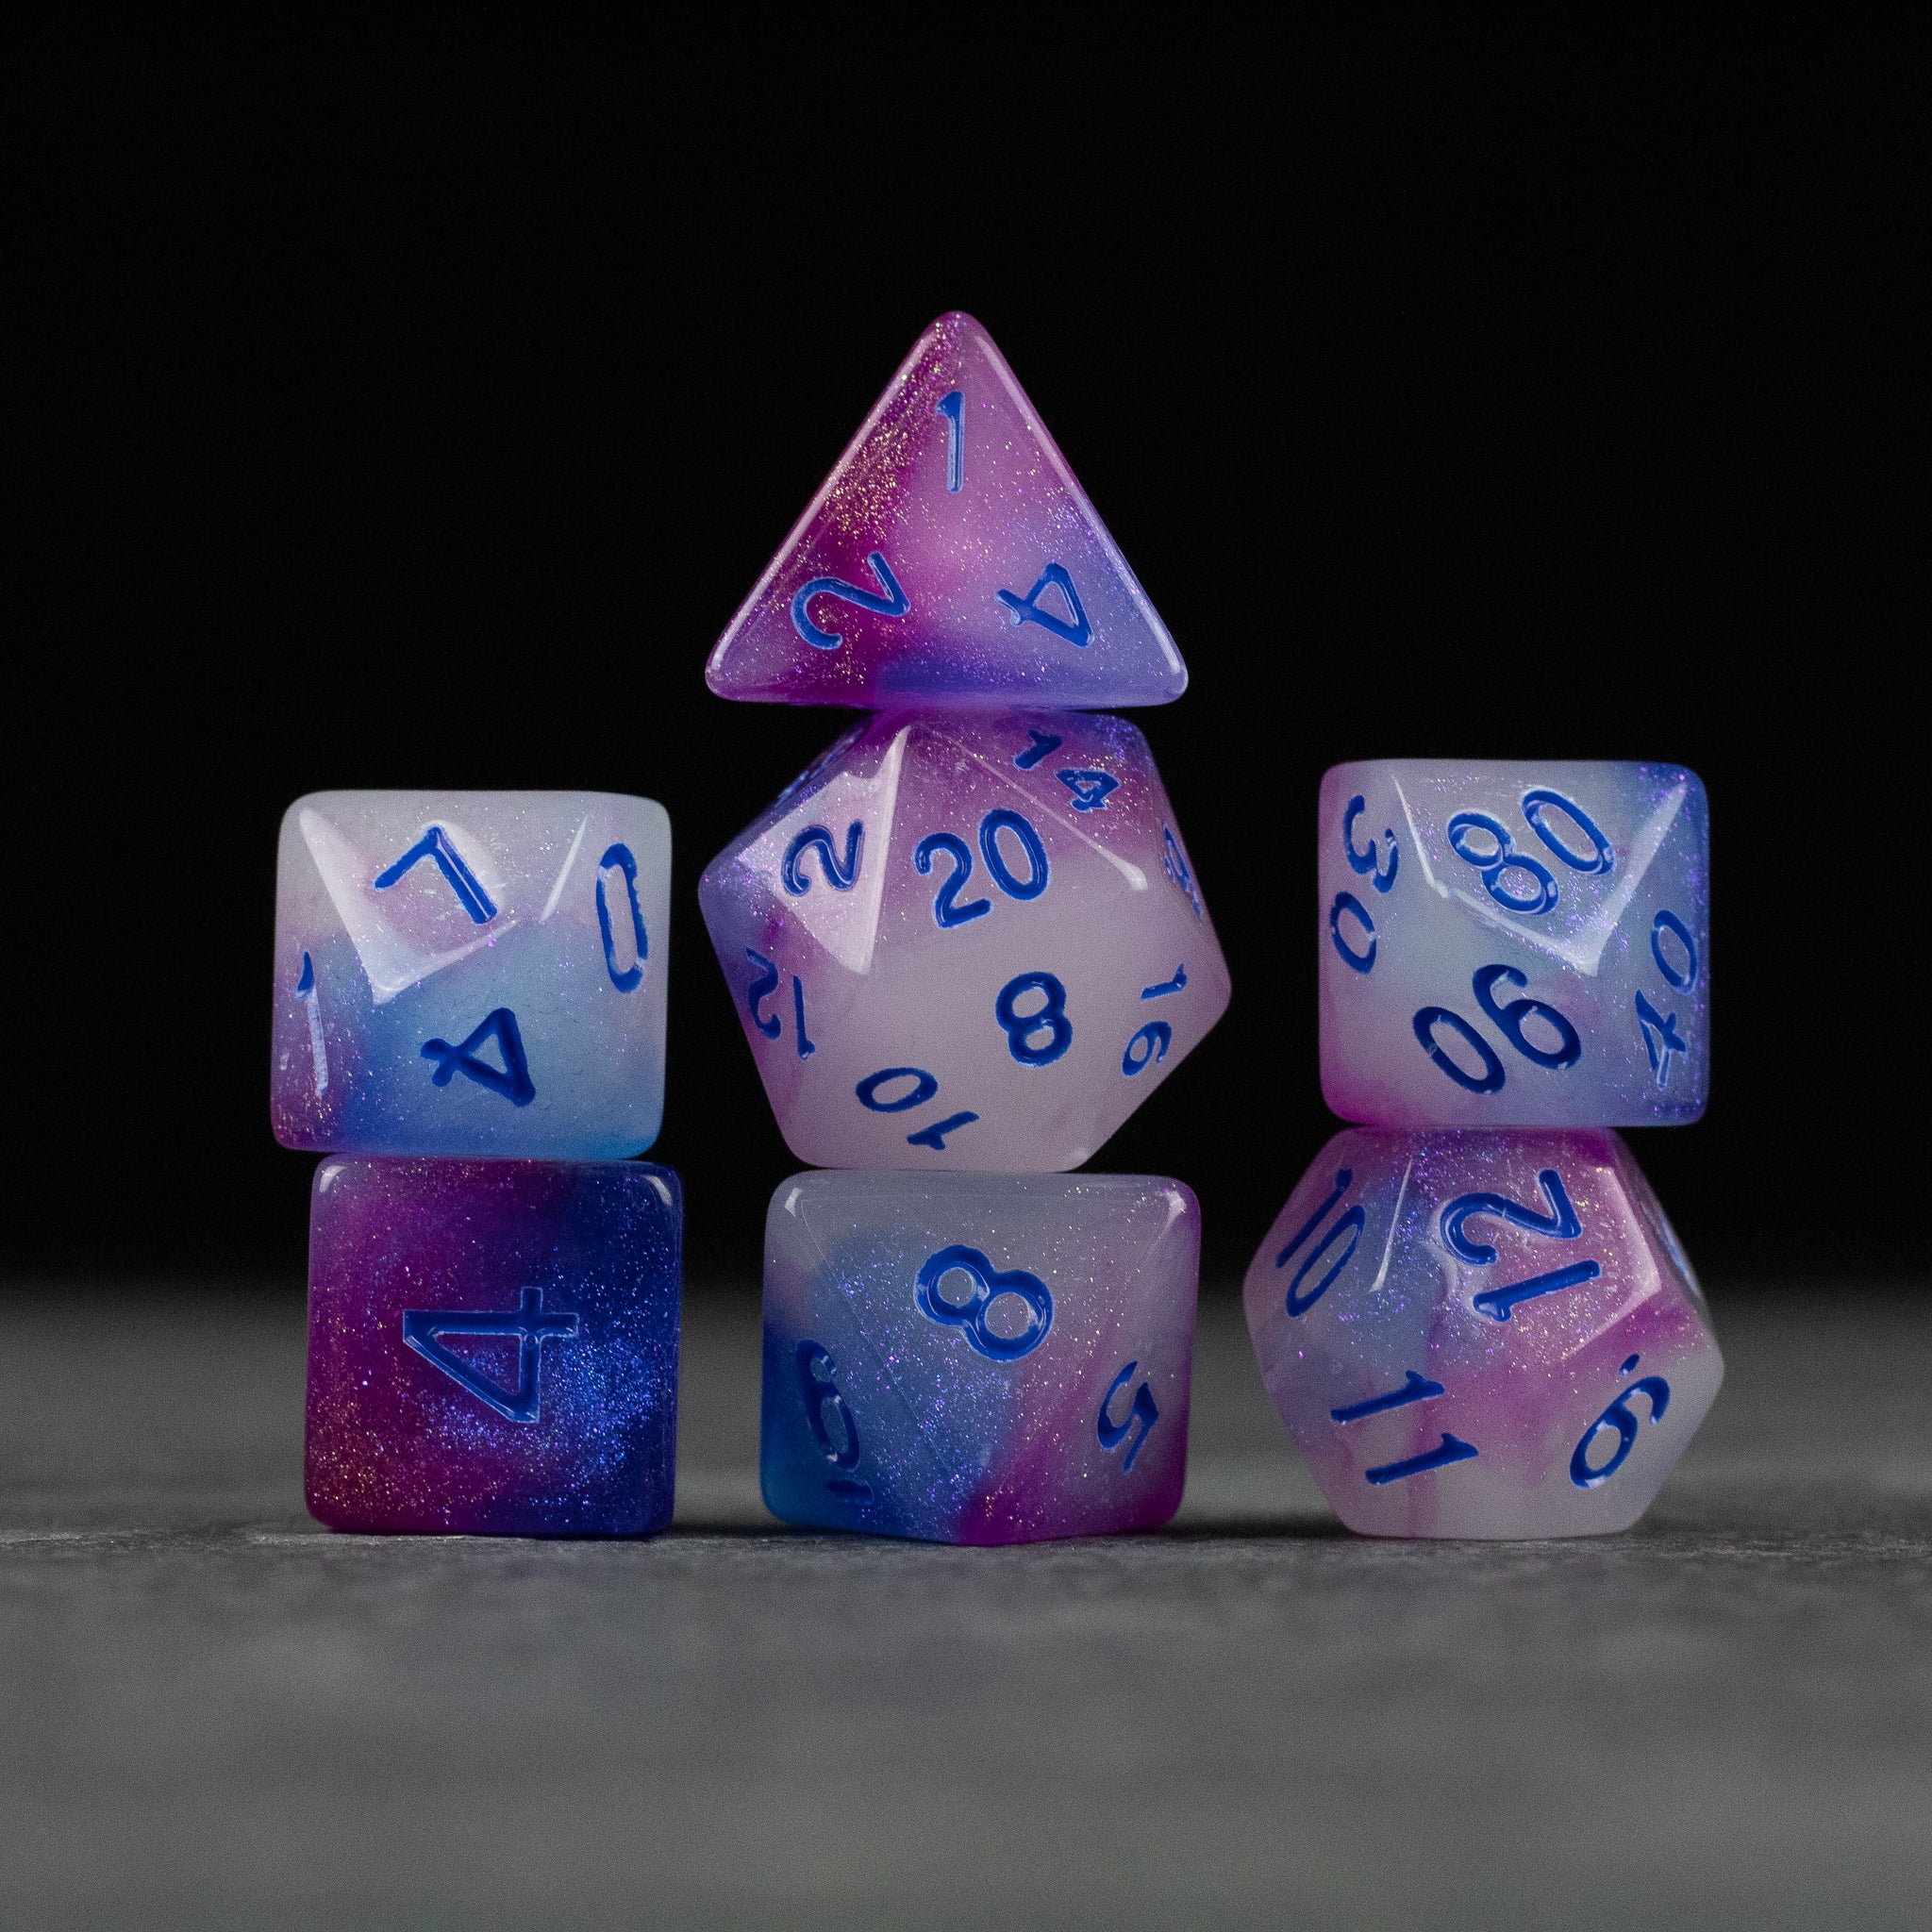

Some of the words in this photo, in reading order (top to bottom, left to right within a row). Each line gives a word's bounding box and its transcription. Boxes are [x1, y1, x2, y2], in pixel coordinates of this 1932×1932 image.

[935, 390, 966, 493] 1
[790, 551, 911, 651] 2
[993, 561, 1095, 648] 4
[1013, 728, 1121, 813] 14
[374, 824, 498, 925] 7
[780, 820, 865, 897] 2
[912, 808, 1052, 929] 20
[1446, 789, 1616, 916] 80
[420, 1007, 537, 1108] 4
[994, 970, 1074, 1068] 8
[1275, 1167, 1366, 1318] 10
[1439, 1168, 1601, 1323] 12
[913, 1243, 1055, 1362] 8
[402, 1286, 580, 1424] 4
[1330, 1370, 1479, 1487] 11
